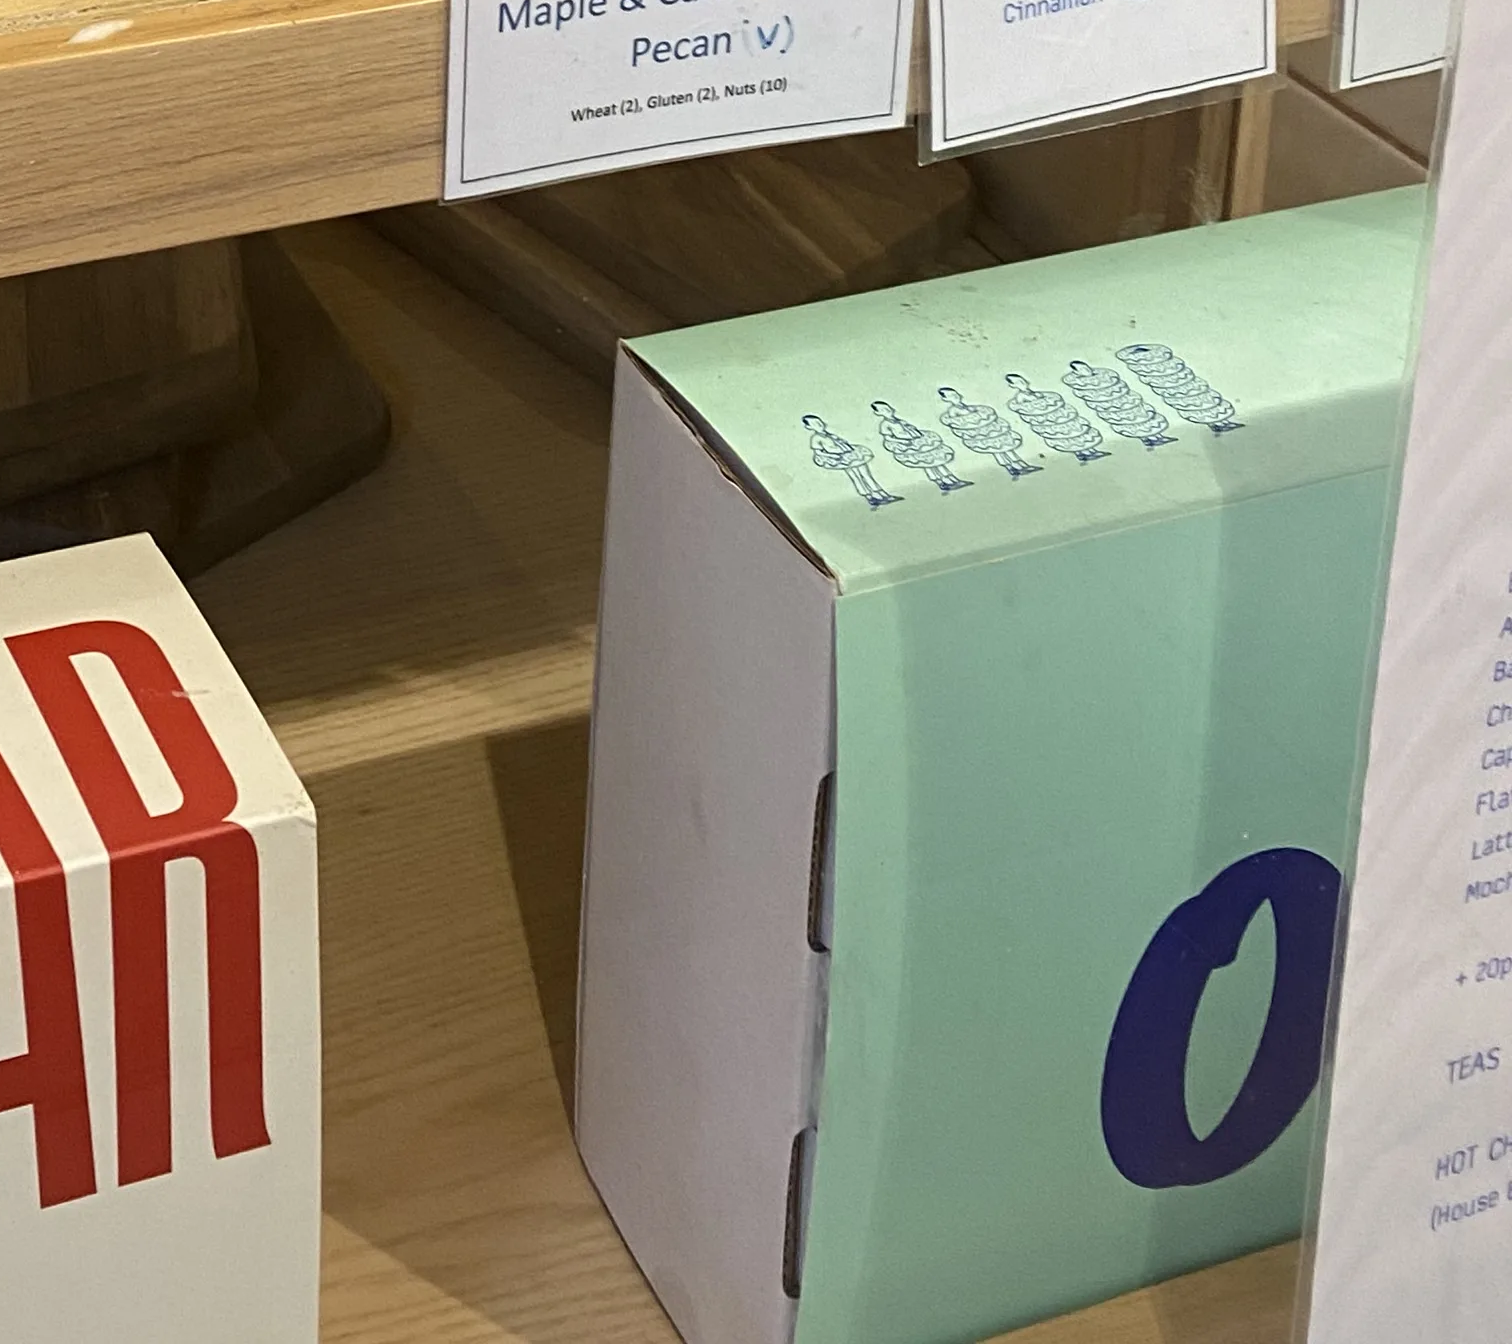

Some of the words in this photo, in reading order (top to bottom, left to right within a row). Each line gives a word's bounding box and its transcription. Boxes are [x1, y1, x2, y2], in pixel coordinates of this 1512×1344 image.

[631, 28, 732, 67] Pecan
[570, 102, 618, 124] Wheat
[619, 97, 644, 119] (2),
[646, 90, 694, 111] Gluten
[696, 85, 721, 106] (2),
[724, 80, 757, 100] Nuts
[759, 76, 788, 98] (10)
[1475, 789, 1512, 815] Fla
[1447, 1046, 1501, 1085] TEAS
[1434, 1143, 1479, 1181] HOT
[1430, 1189, 1500, 1232] (House
